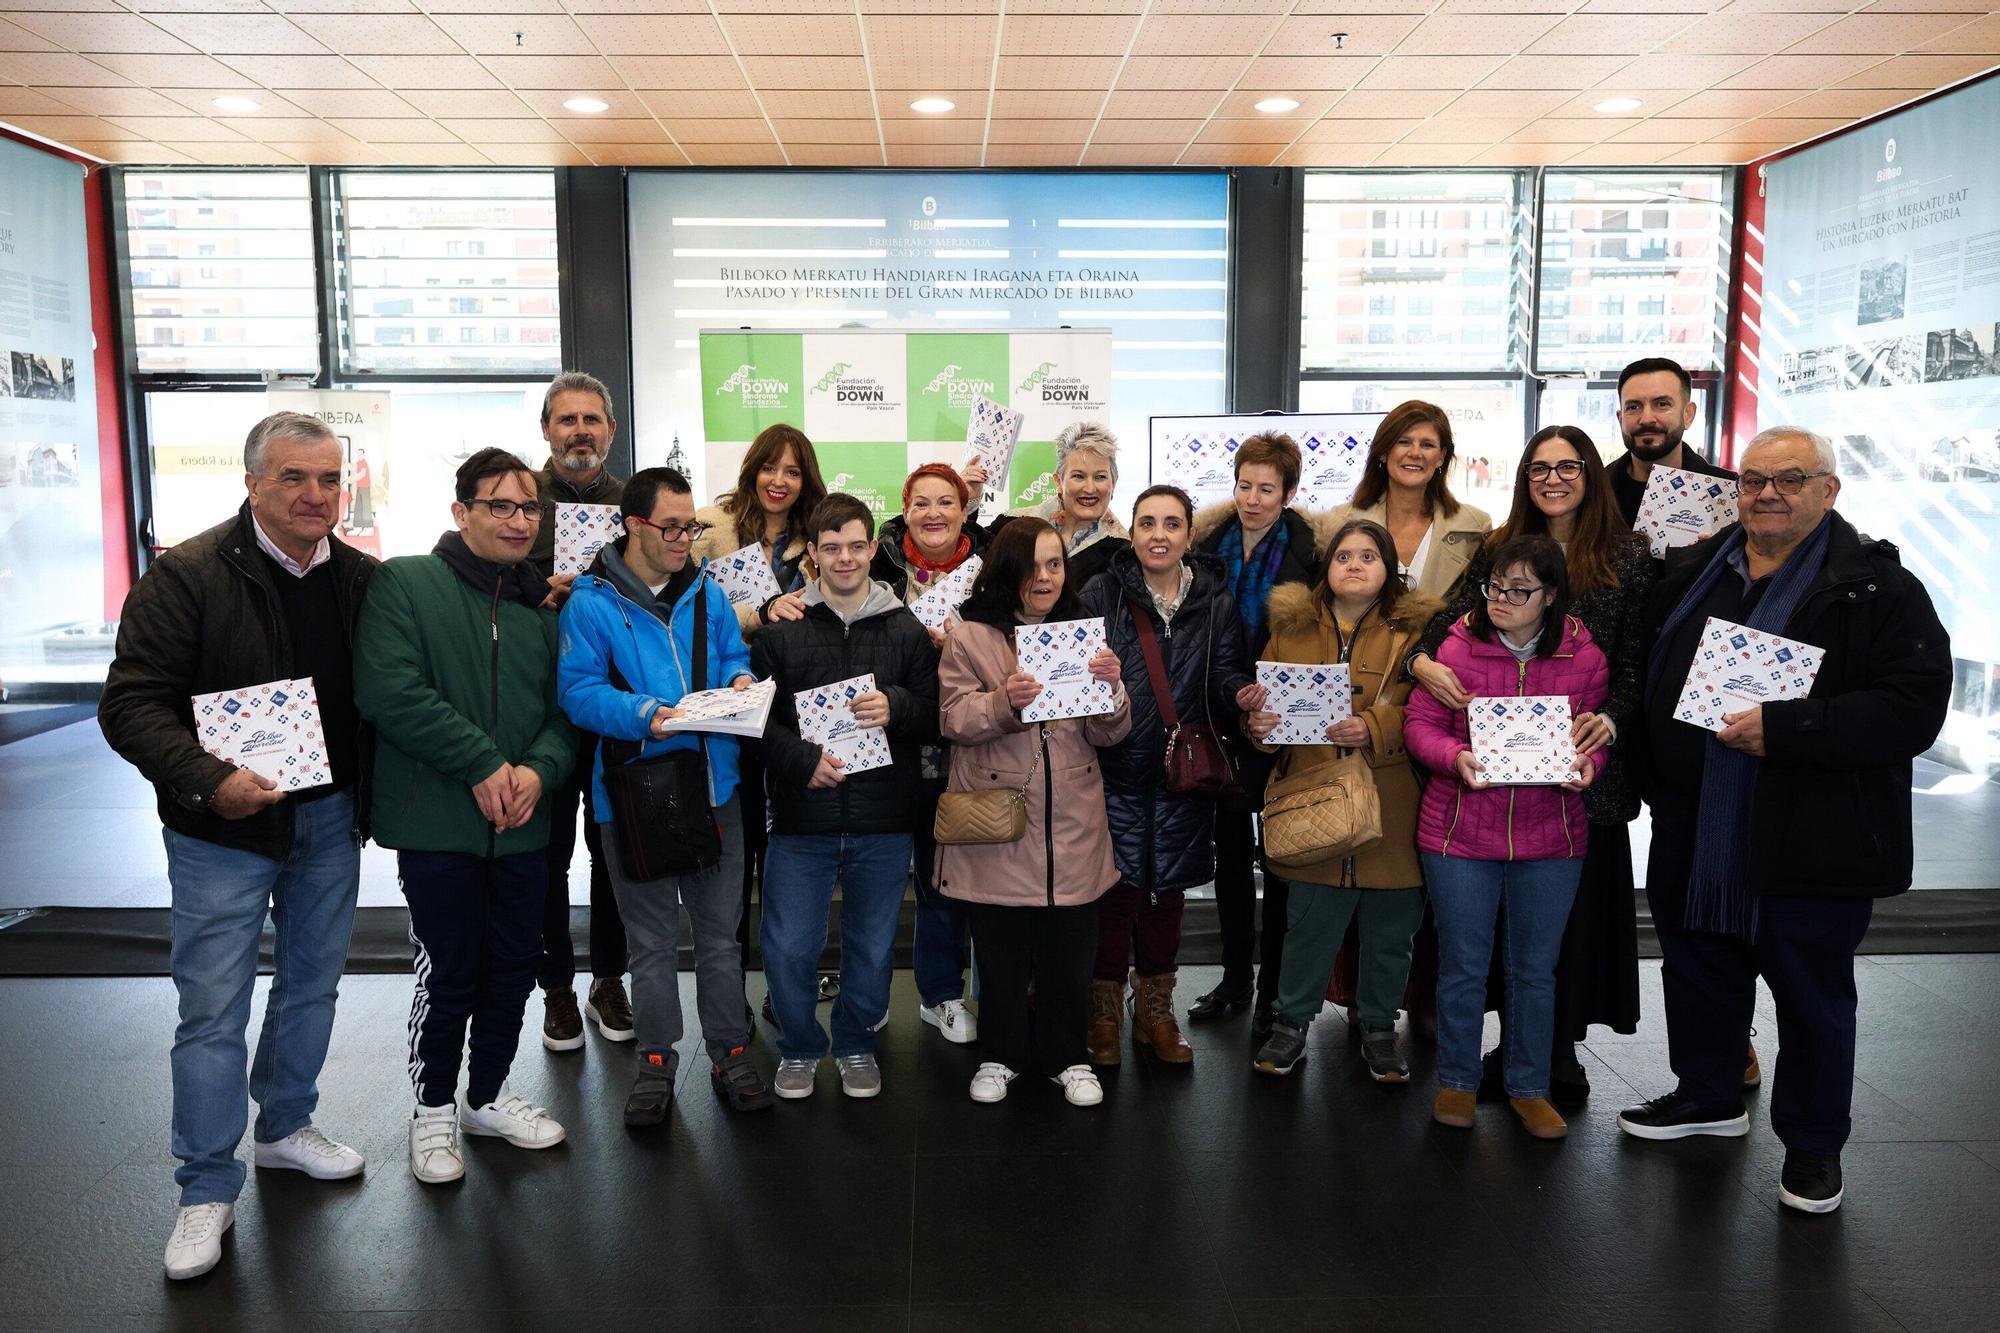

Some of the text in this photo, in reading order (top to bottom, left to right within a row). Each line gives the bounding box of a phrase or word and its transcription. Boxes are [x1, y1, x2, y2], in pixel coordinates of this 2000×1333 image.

[1876, 166, 1902, 183] Bilbao
[1816, 188, 1969, 242] HISTORIA LUZEKO MERKATU BAT
[1823, 207, 1961, 252] UN MERCADO CON HISTORIA
[720, 268, 787, 282] BILBOKO
[793, 268, 867, 282] MERKATU
[873, 268, 968, 282] HANDIAREN
[974, 268, 1042, 282] IRAGANA
[1079, 269, 1139, 282] ORAINA
[725, 286, 1134, 299] PASADO Y PRESENTE DEL GRAN MERCADO DE BILBAO
[741, 382, 789, 393] DOWN
[948, 383, 994, 393] DOWN
[837, 391, 884, 402] DOWN
[1042, 391, 1089, 401] DOWN
[838, 487, 877, 495] Fundación
